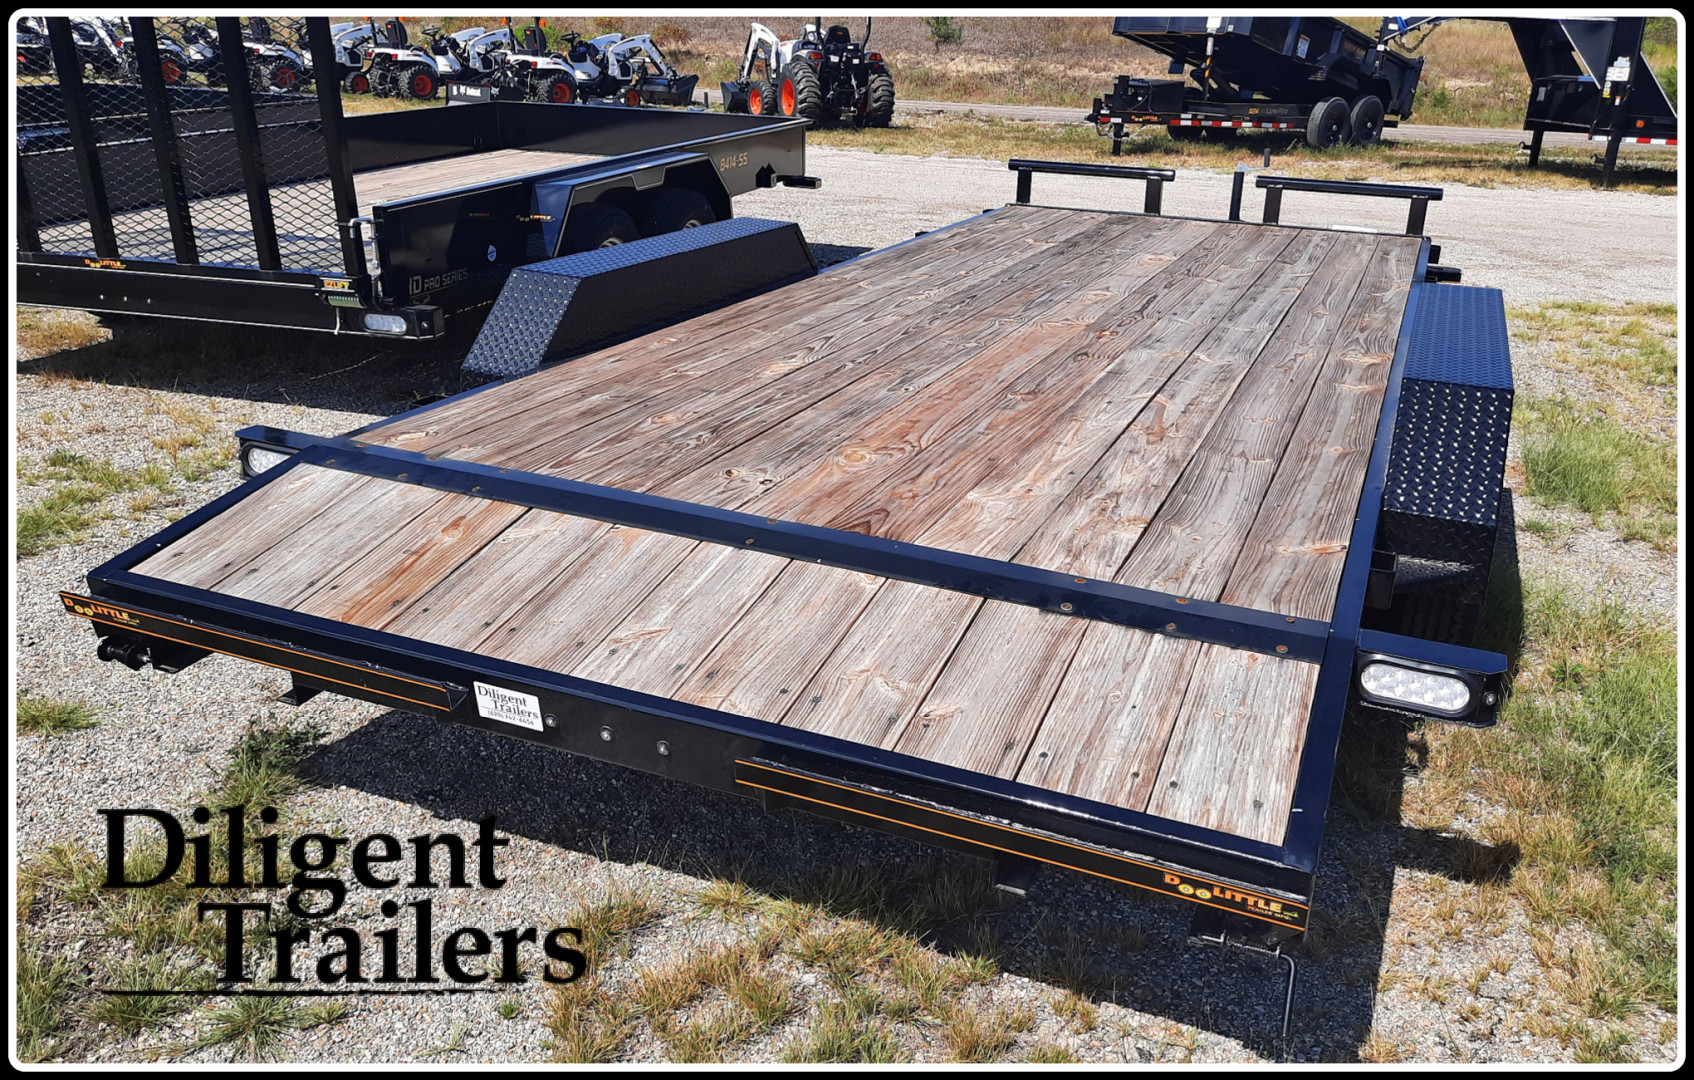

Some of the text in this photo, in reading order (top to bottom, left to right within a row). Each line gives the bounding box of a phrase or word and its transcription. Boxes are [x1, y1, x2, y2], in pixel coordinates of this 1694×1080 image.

[424, 275, 441, 291] PRO
[442, 267, 469, 287] SERIES
[63, 597, 131, 621] DOOLITTLE
[476, 684, 528, 707] Diligent
[490, 698, 539, 720] Trailers
[1163, 872, 1283, 914] DOOLITTLE
